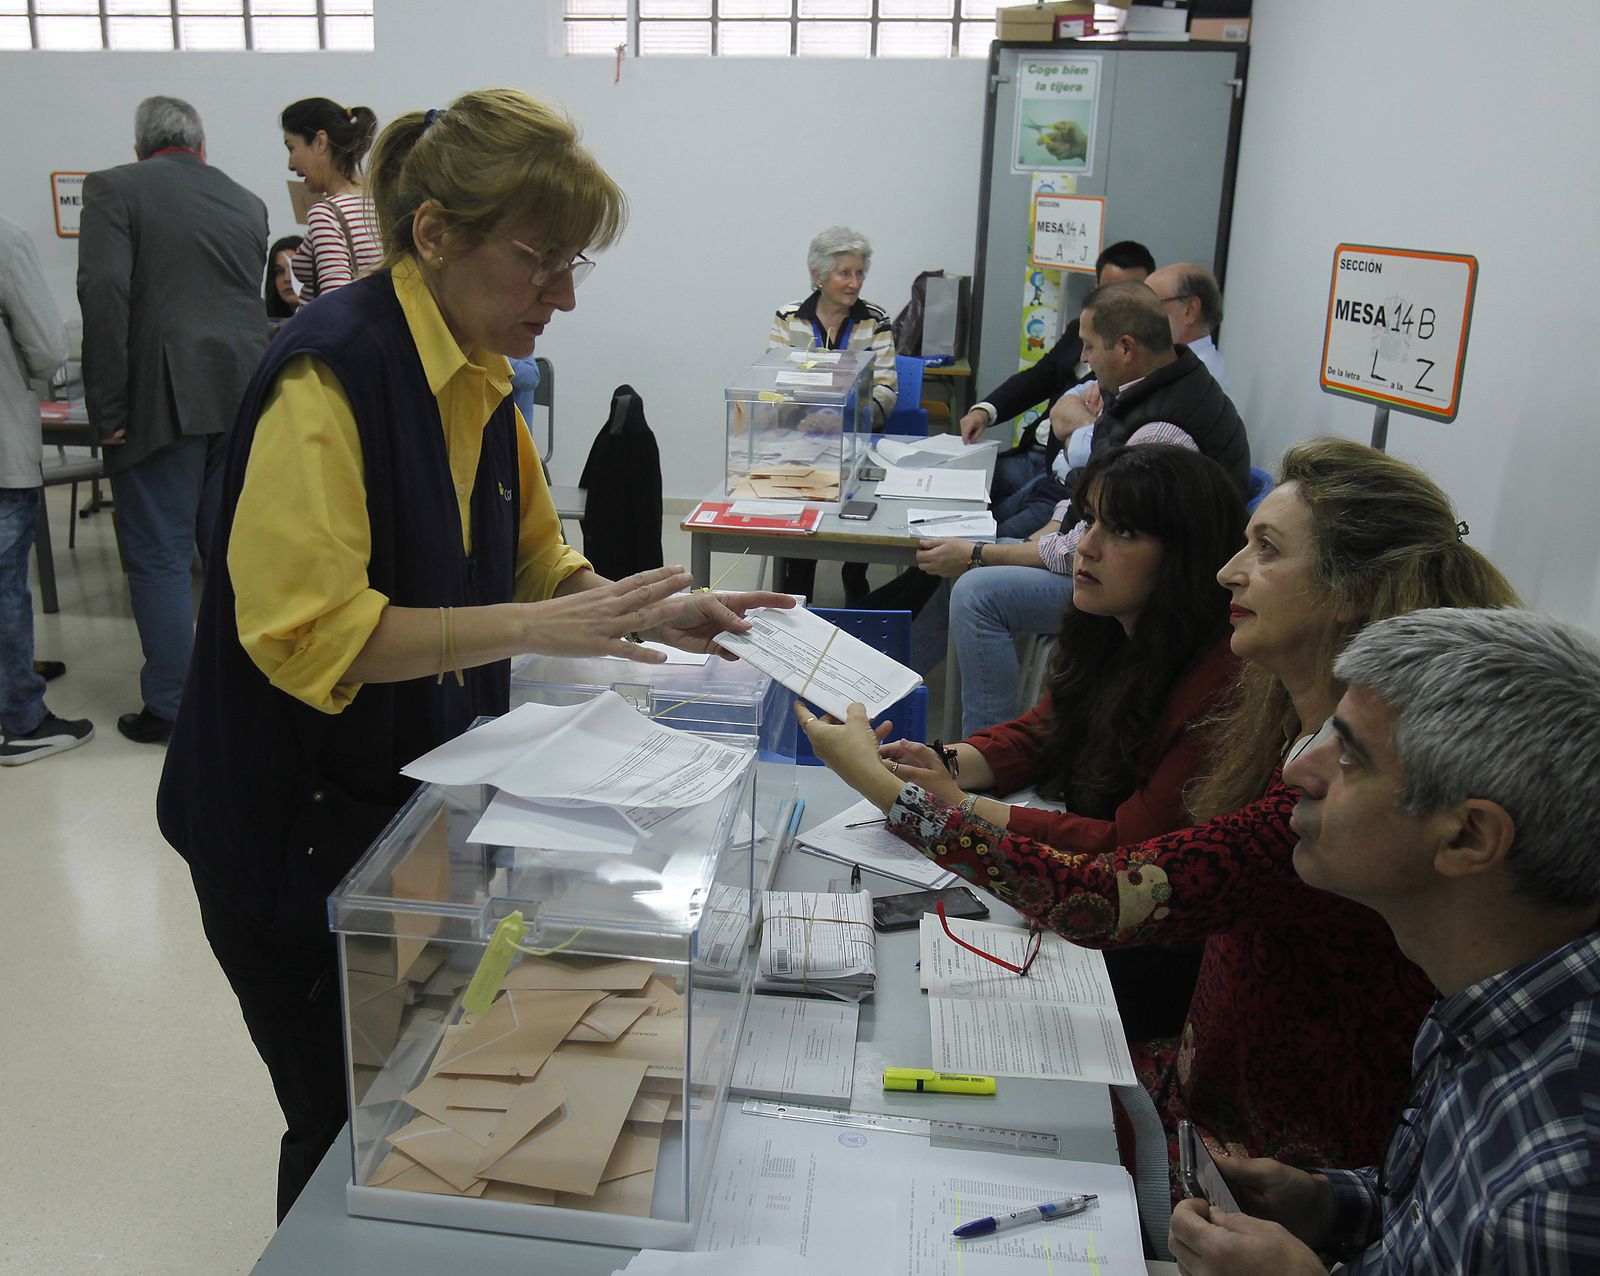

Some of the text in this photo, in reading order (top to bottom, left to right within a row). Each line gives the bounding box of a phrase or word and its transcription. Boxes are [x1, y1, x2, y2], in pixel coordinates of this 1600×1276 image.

[1028, 64, 1089, 76] Coge bien
[1035, 81, 1083, 93] la tijera
[60, 196, 80, 206] ME
[1037, 221, 1064, 234] MESA
[1340, 258, 1382, 274] SECCIÓN
[1335, 299, 1387, 327] MESA
[1327, 366, 1336, 375] De
[1337, 368, 1344, 377] la
[1344, 369, 1360, 381] letra
[1370, 349, 1387, 381] L
[1396, 381, 1403, 391] la
[1414, 358, 1435, 392] Z
